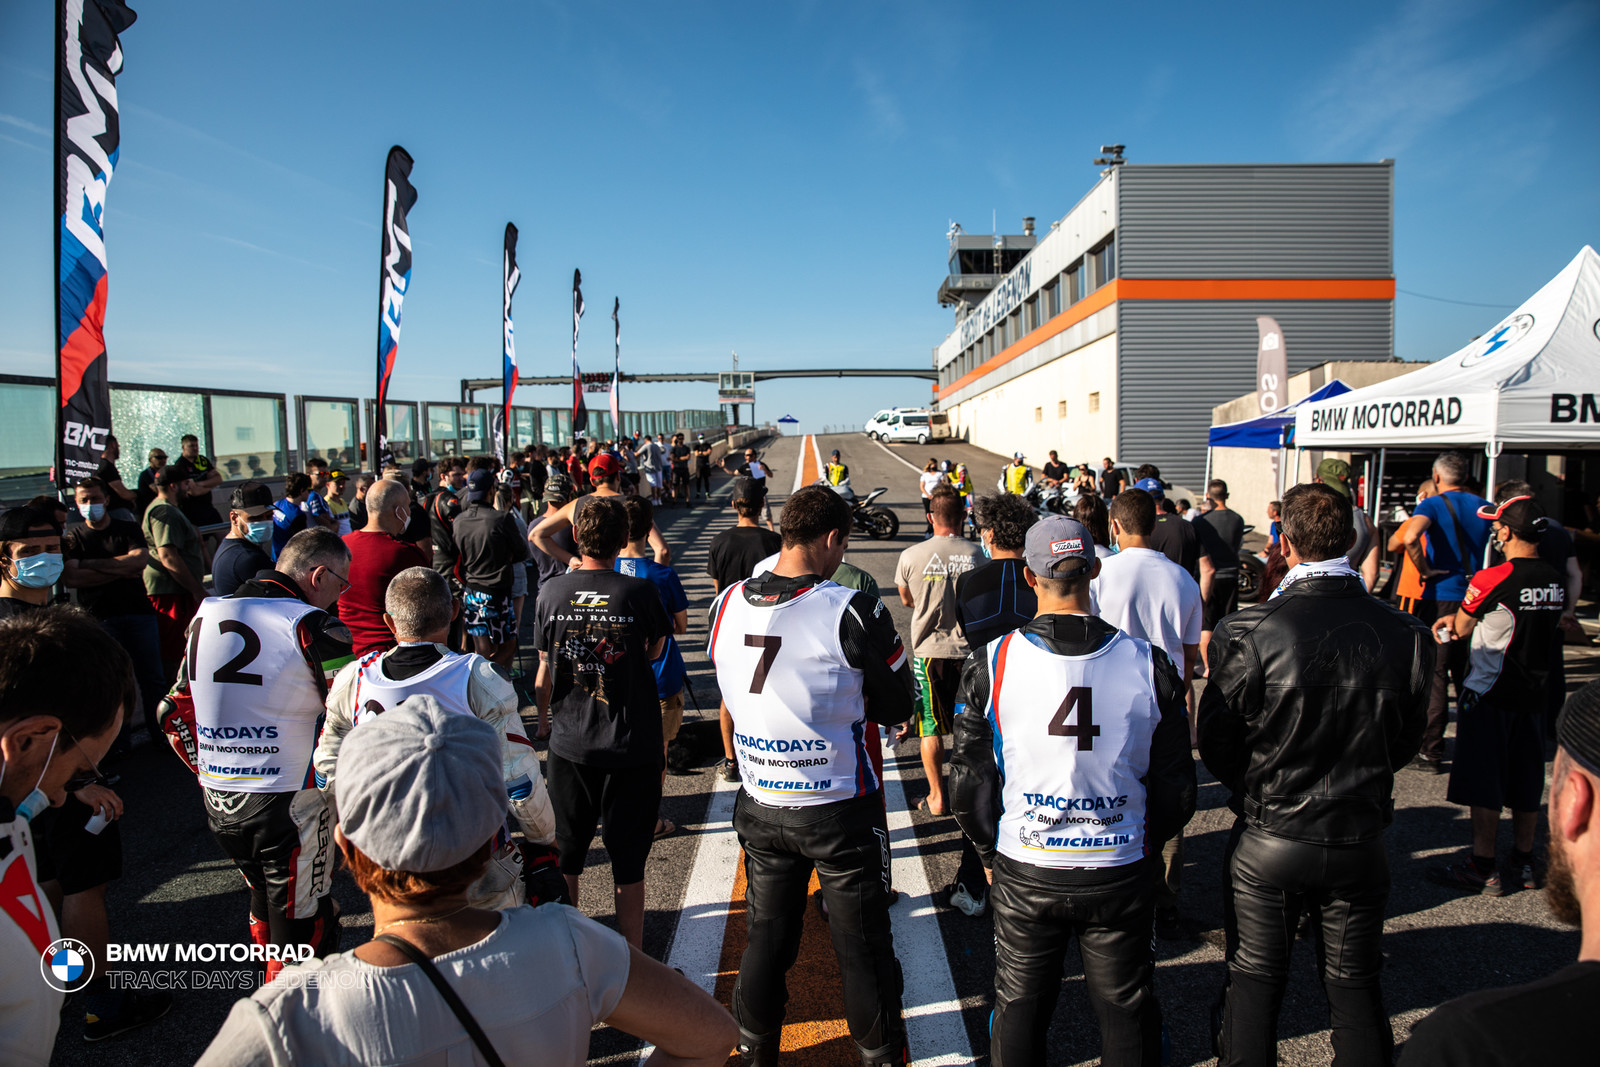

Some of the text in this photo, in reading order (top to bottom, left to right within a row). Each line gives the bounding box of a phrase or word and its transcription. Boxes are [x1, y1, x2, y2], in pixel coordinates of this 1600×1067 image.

[992, 257, 1032, 324] LEDENON
[1312, 407, 1348, 432] BMW
[1352, 397, 1463, 430] MOTORRAD
[1550, 393, 1600, 423] BM
[63, 420, 110, 452] BMC
[1054, 541, 1082, 552] Titleist
[574, 590, 610, 608] TT
[1519, 583, 1565, 606] aprilia
[549, 614, 634, 623] ROAD RACES
[189, 616, 263, 687] 12
[744, 633, 782, 694] 7
[1048, 686, 1101, 751] 4
[196, 723, 279, 740] ACKDAYS
[216, 745, 280, 754] MOTORRAD
[735, 732, 827, 753] TRACKDAYS
[208, 764, 281, 776] MICHELIN
[748, 753, 829, 769] BMW MOTORRAD
[757, 778, 832, 790] MICHELIN
[1023, 793, 1129, 812] TRACKDAYS
[1037, 813, 1124, 827] BMW MOTORRAD
[1045, 834, 1130, 848] MICHELIN
